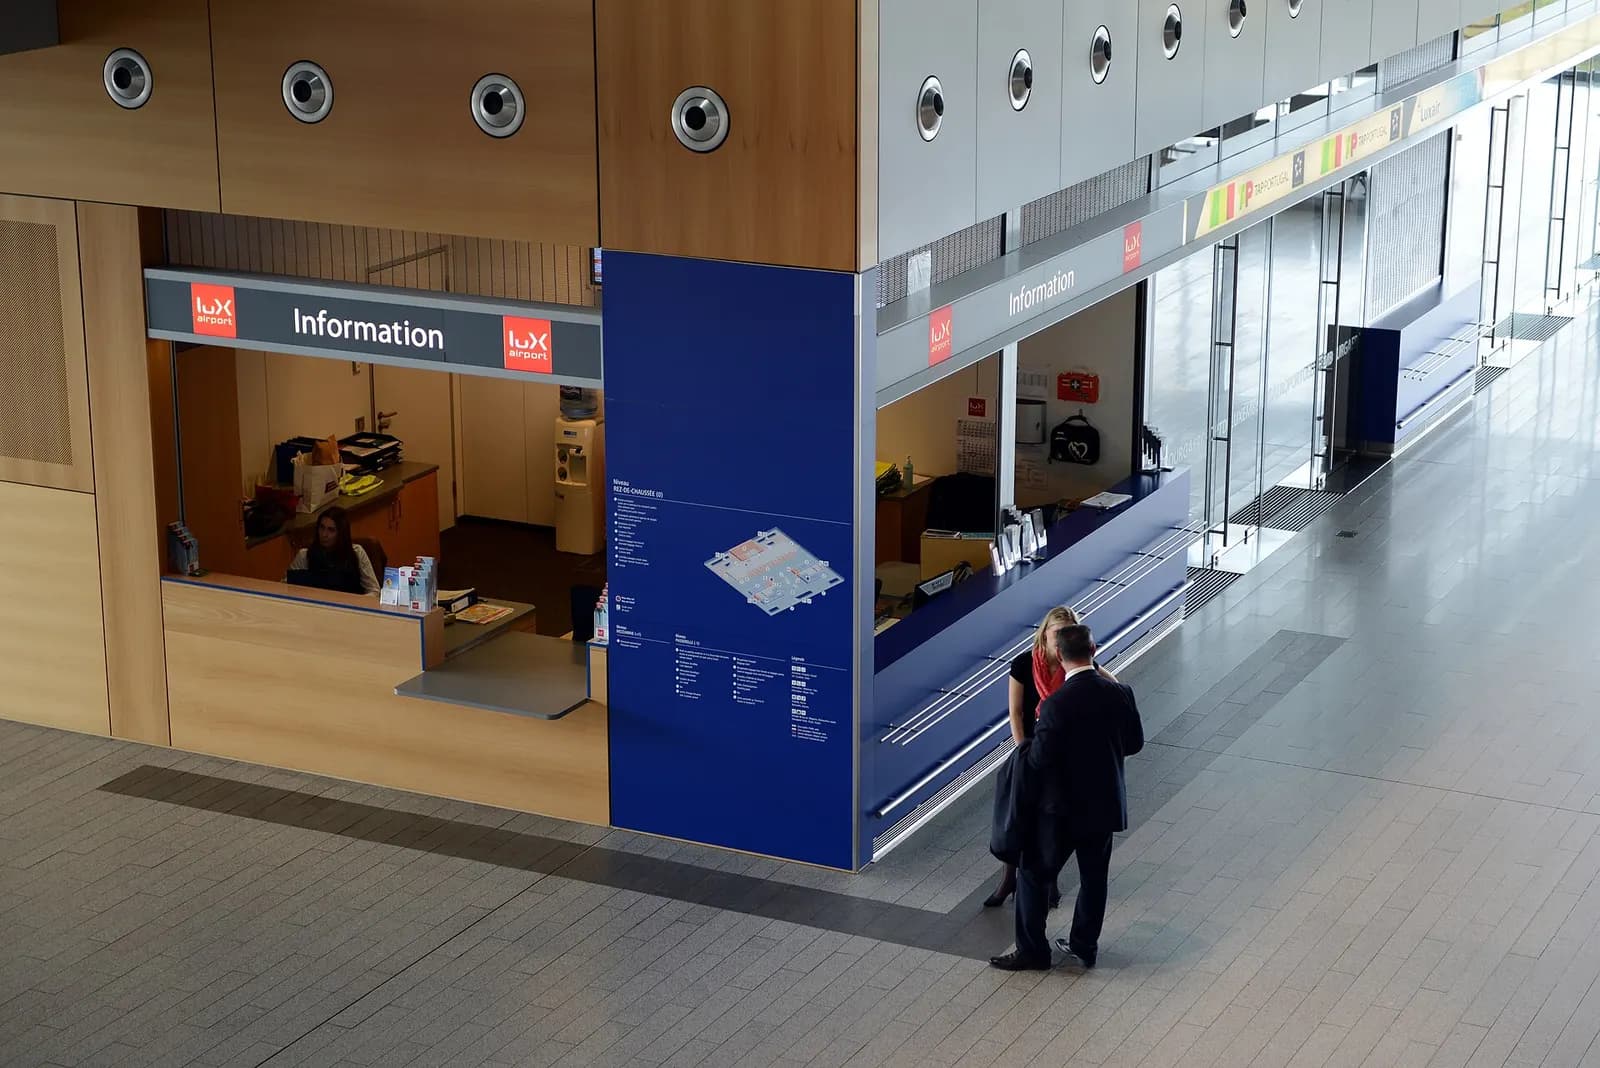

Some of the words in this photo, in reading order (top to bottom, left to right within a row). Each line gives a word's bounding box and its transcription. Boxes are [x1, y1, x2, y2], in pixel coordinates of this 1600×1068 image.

[1009, 269, 1075, 317] Information
[197, 315, 232, 325] airport
[294, 308, 444, 350] Information
[509, 350, 548, 361] airport
